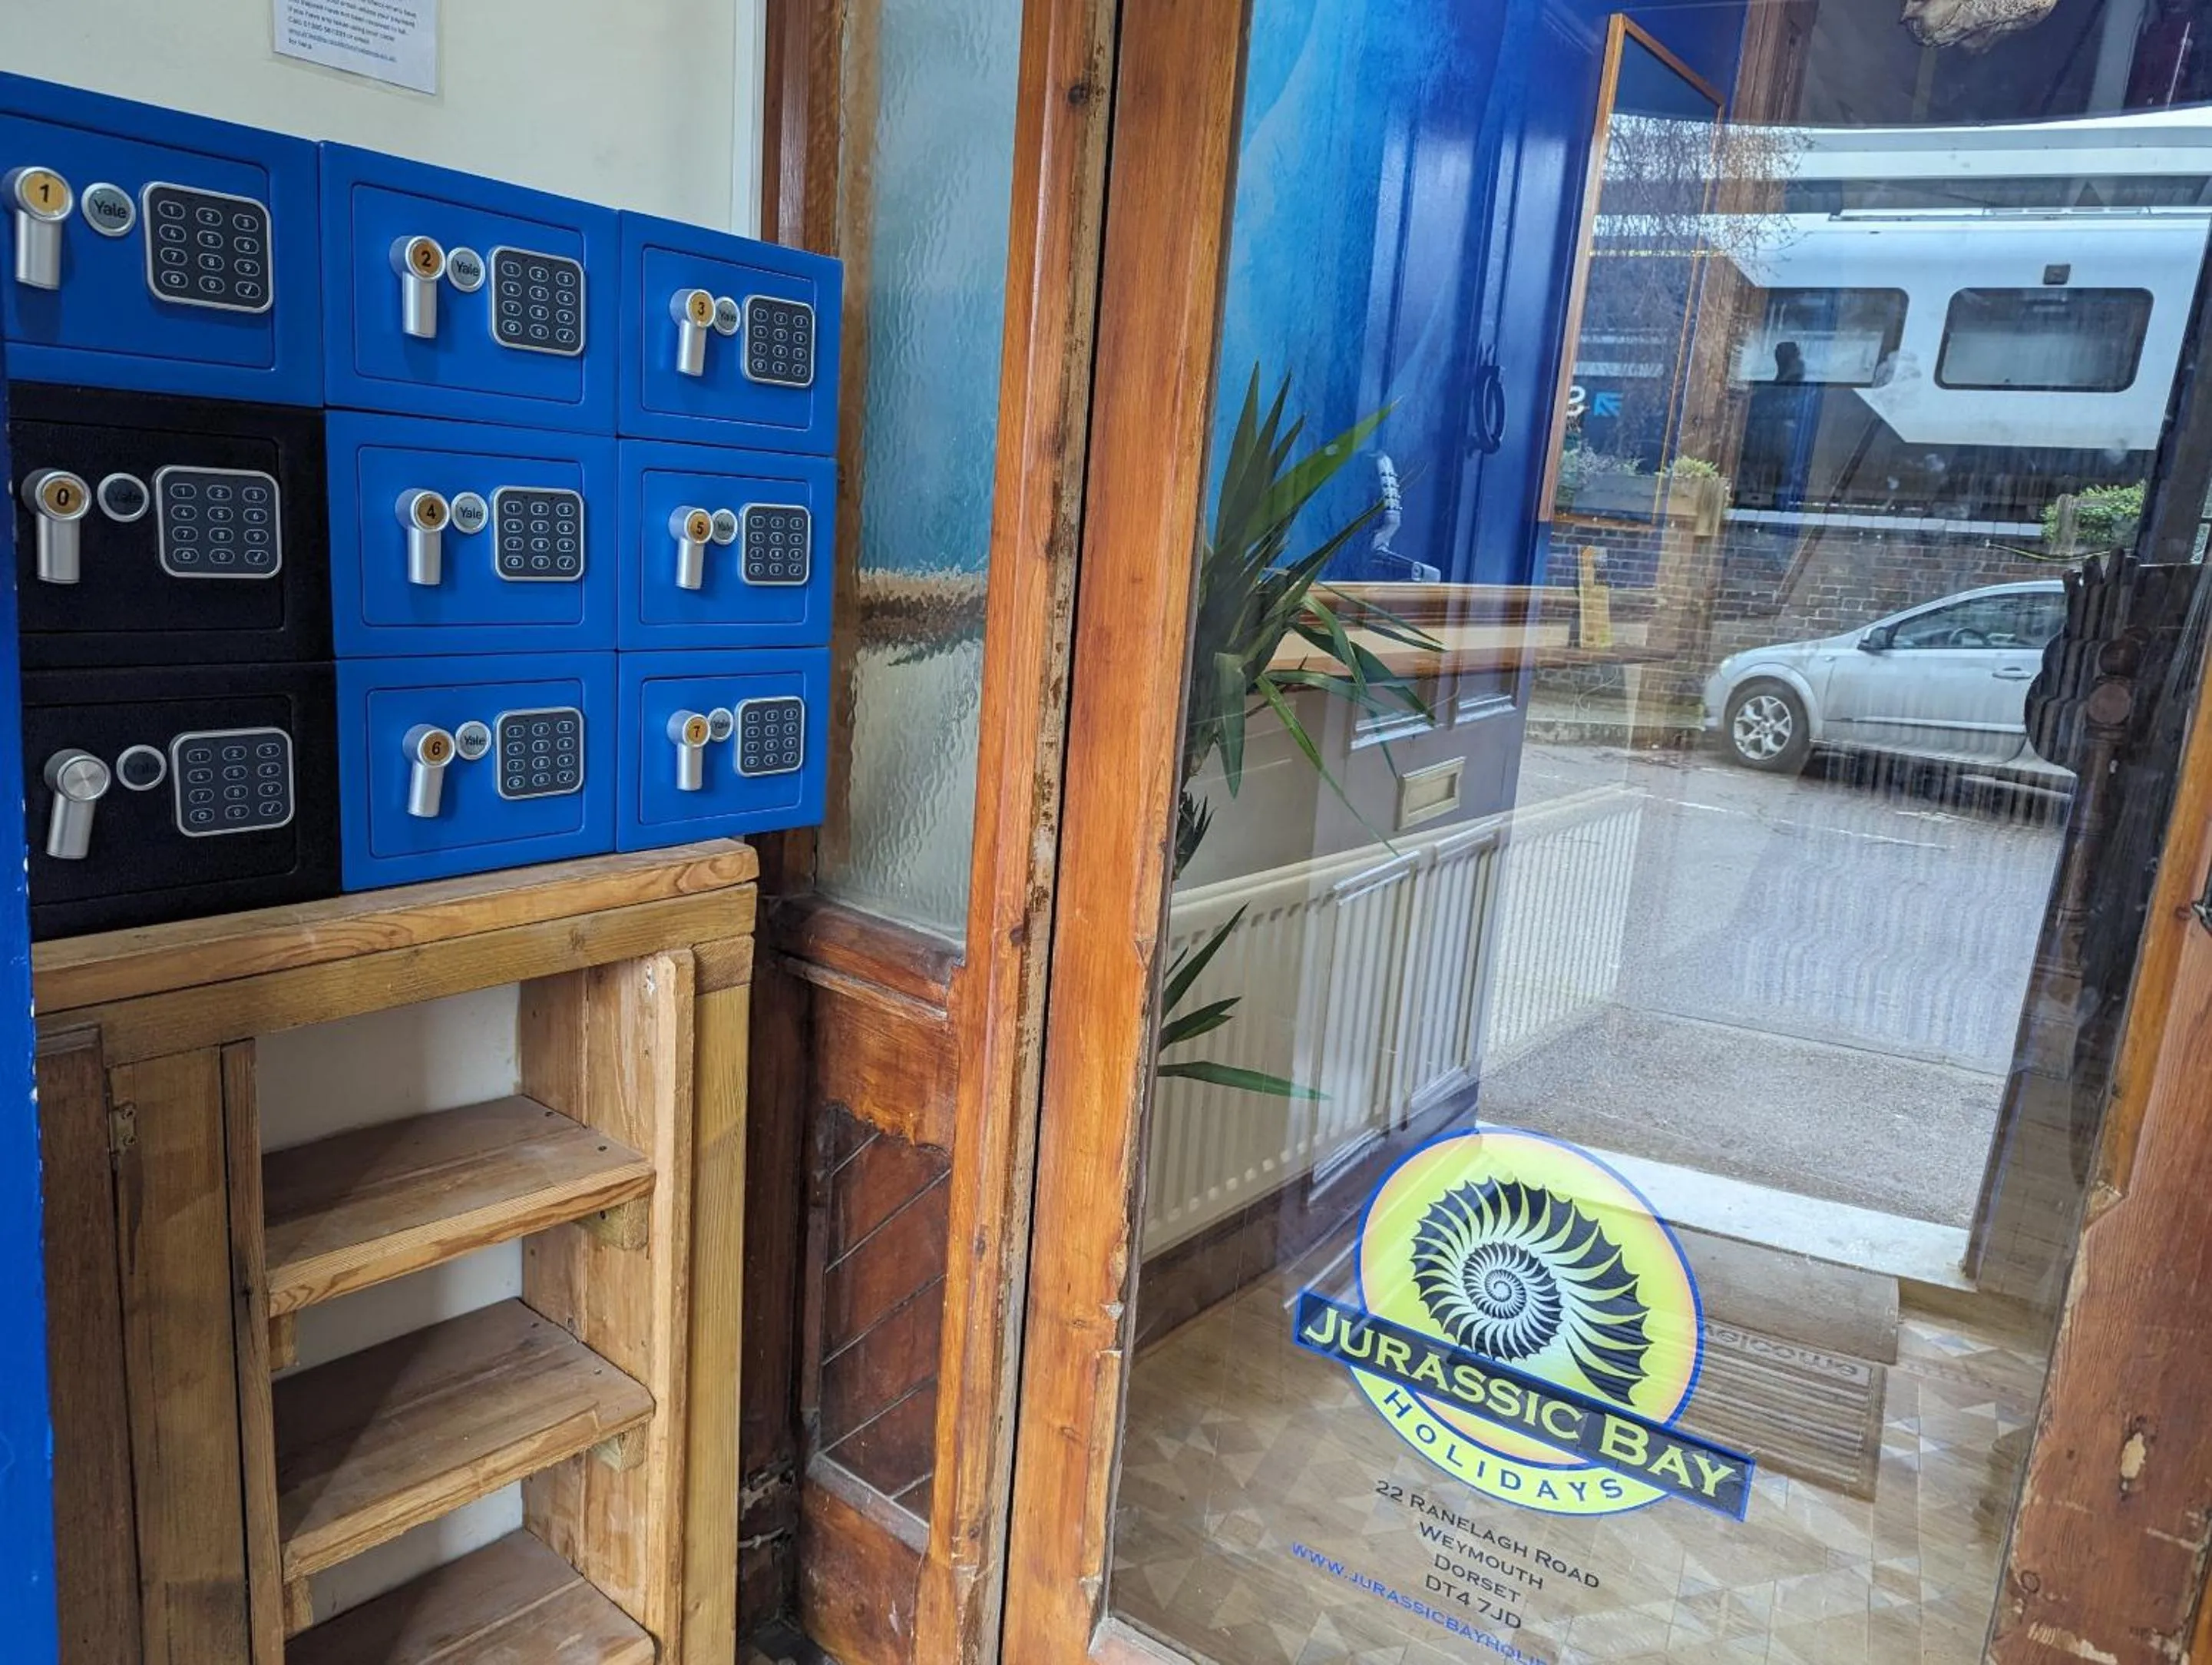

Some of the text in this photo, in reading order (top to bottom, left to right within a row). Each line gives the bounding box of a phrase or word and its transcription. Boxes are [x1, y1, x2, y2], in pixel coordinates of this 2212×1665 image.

[40, 184, 50, 203] 1
[94, 199, 127, 219] Yale
[422, 250, 431, 267] 2
[456, 260, 481, 277] Yale
[697, 301, 706, 316] 3
[56, 488, 70, 507] 0
[426, 504, 436, 519] 4
[459, 506, 483, 520] Yale
[696, 521, 704, 536] 5
[465, 734, 486, 746] Yale
[693, 725, 701, 738] 7
[431, 741, 441, 756] 6
[1304, 1307, 1735, 1497] JURASSIC BAY
[1384, 1389, 1623, 1502] HOLIDAYS
[1375, 1480, 1600, 1588] 22 RANELAGH ROAD
[1419, 1521, 1544, 1591] WEYMOUTH
[1434, 1553, 1521, 1604] DORSET
[1425, 1574, 1523, 1630] DT4 7JD
